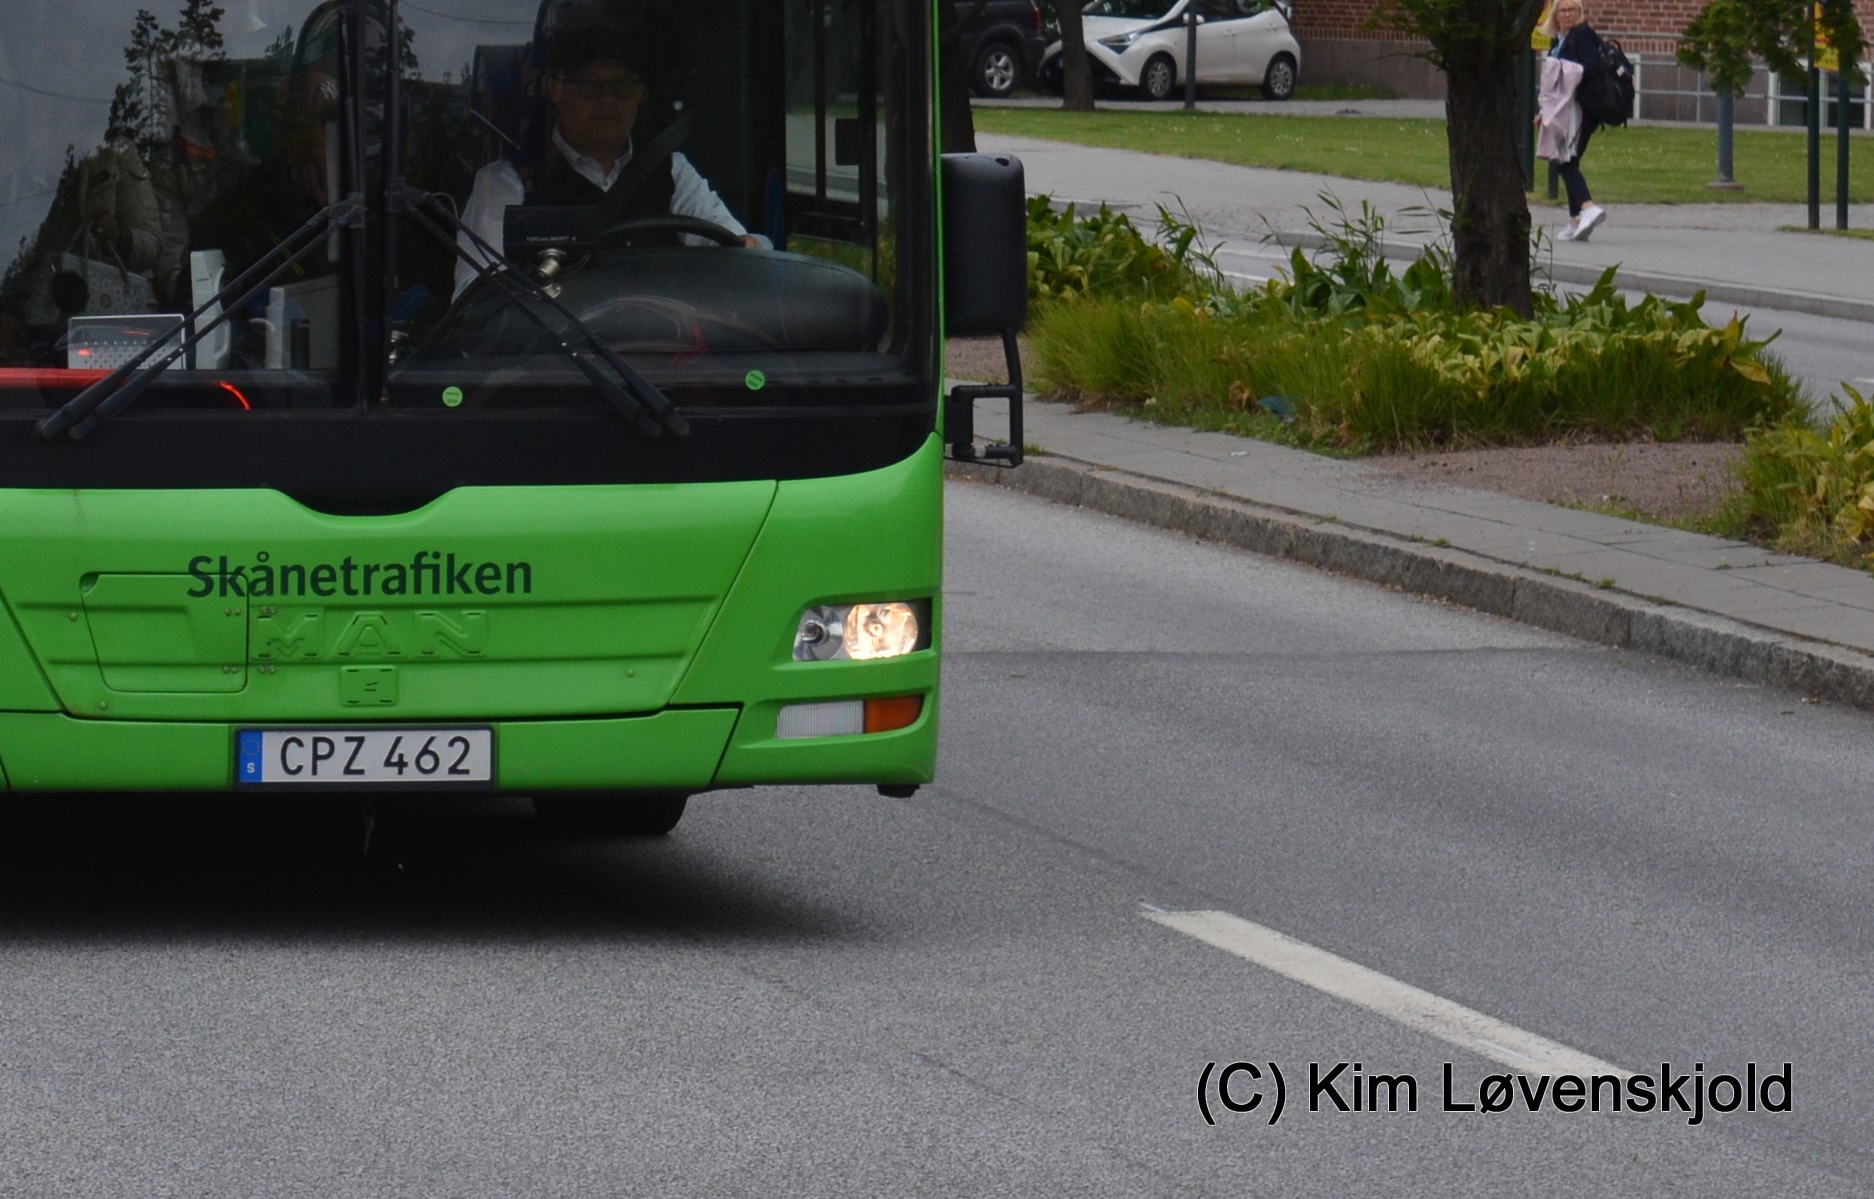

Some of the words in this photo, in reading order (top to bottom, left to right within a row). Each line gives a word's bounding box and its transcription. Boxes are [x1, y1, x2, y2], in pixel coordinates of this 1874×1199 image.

[187, 551, 532, 598] Skånetrafiken
[254, 608, 487, 660] MAN
[246, 762, 256, 774] S
[280, 735, 366, 776] CPZ
[383, 735, 471, 776] 462
